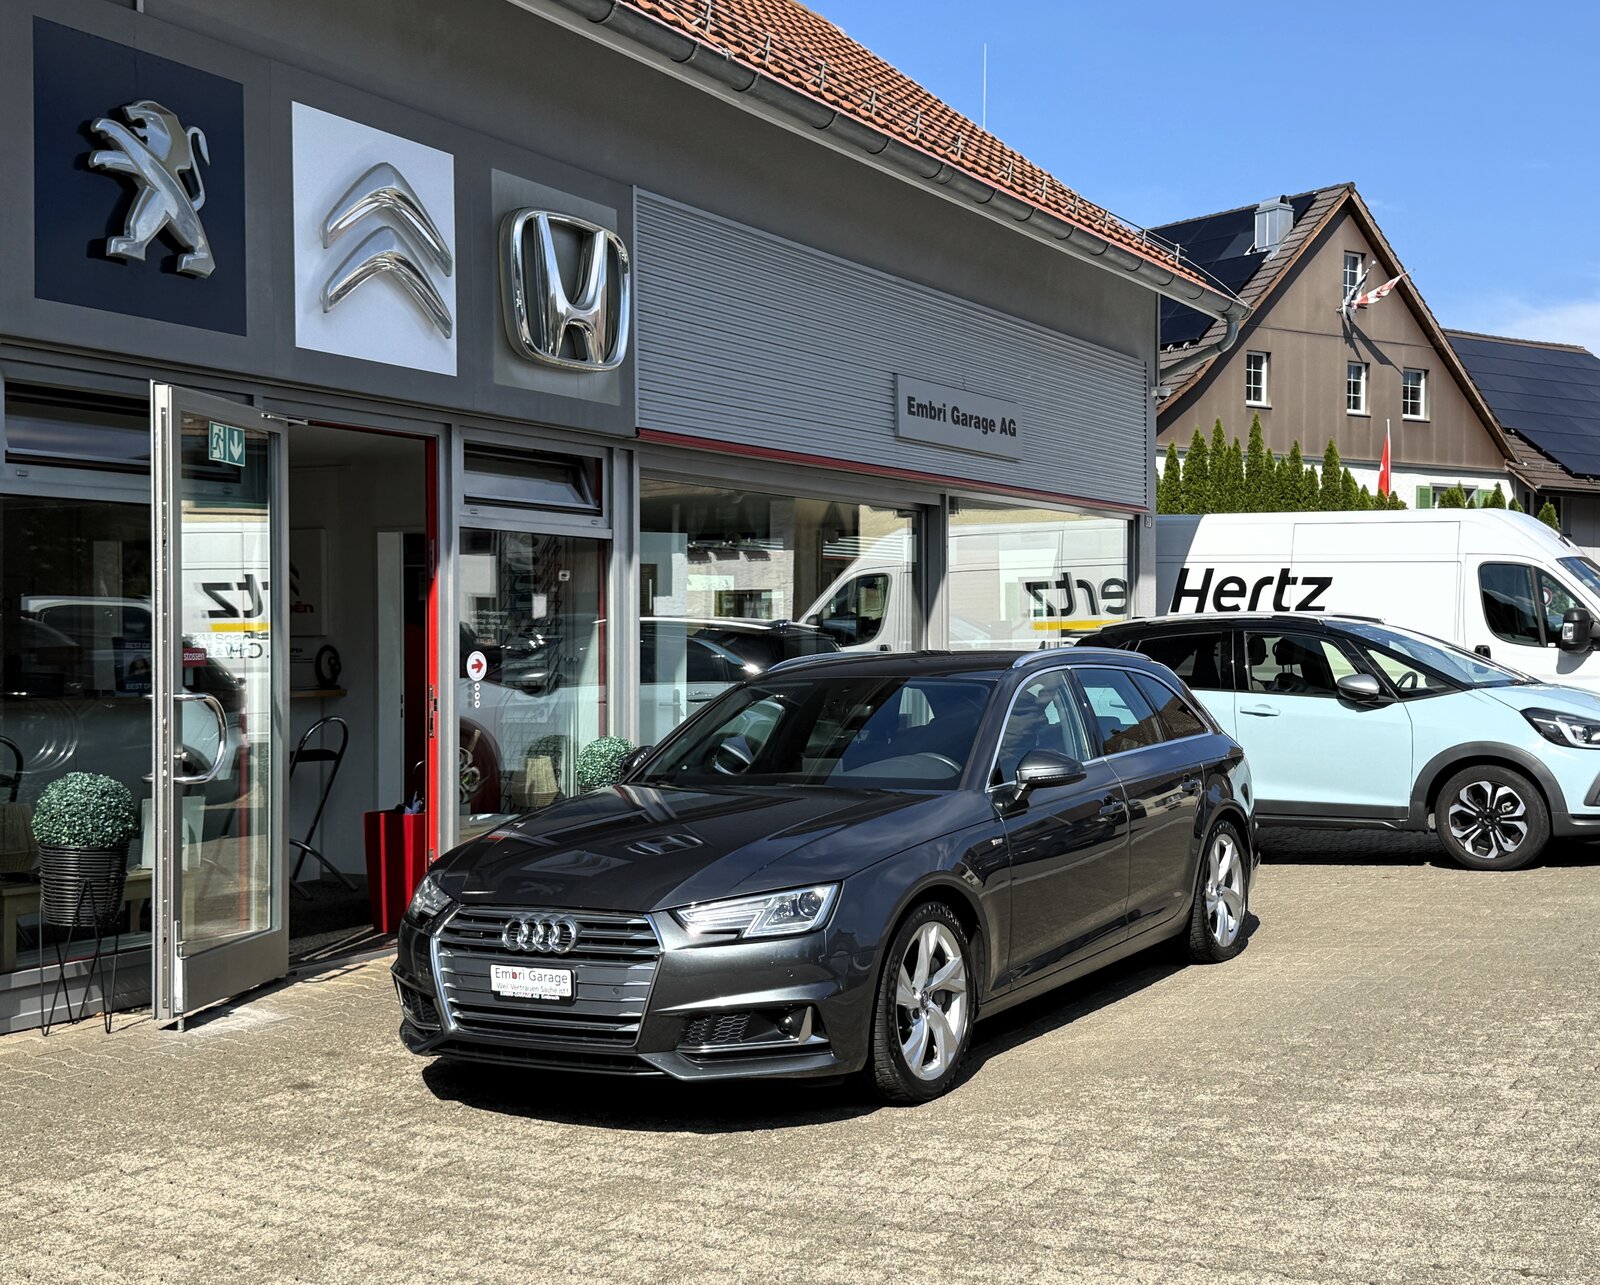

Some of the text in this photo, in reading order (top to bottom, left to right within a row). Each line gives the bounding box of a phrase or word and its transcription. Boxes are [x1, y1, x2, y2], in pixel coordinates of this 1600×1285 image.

[907, 395, 1017, 437] Embri Garage AG
[1169, 567, 1334, 613] Hertz
[183, 651, 205, 660] stossen
[495, 967, 568, 986] Embri Garage
[510, 984, 540, 992] Vertrauen
[541, 986, 558, 994] Sache
